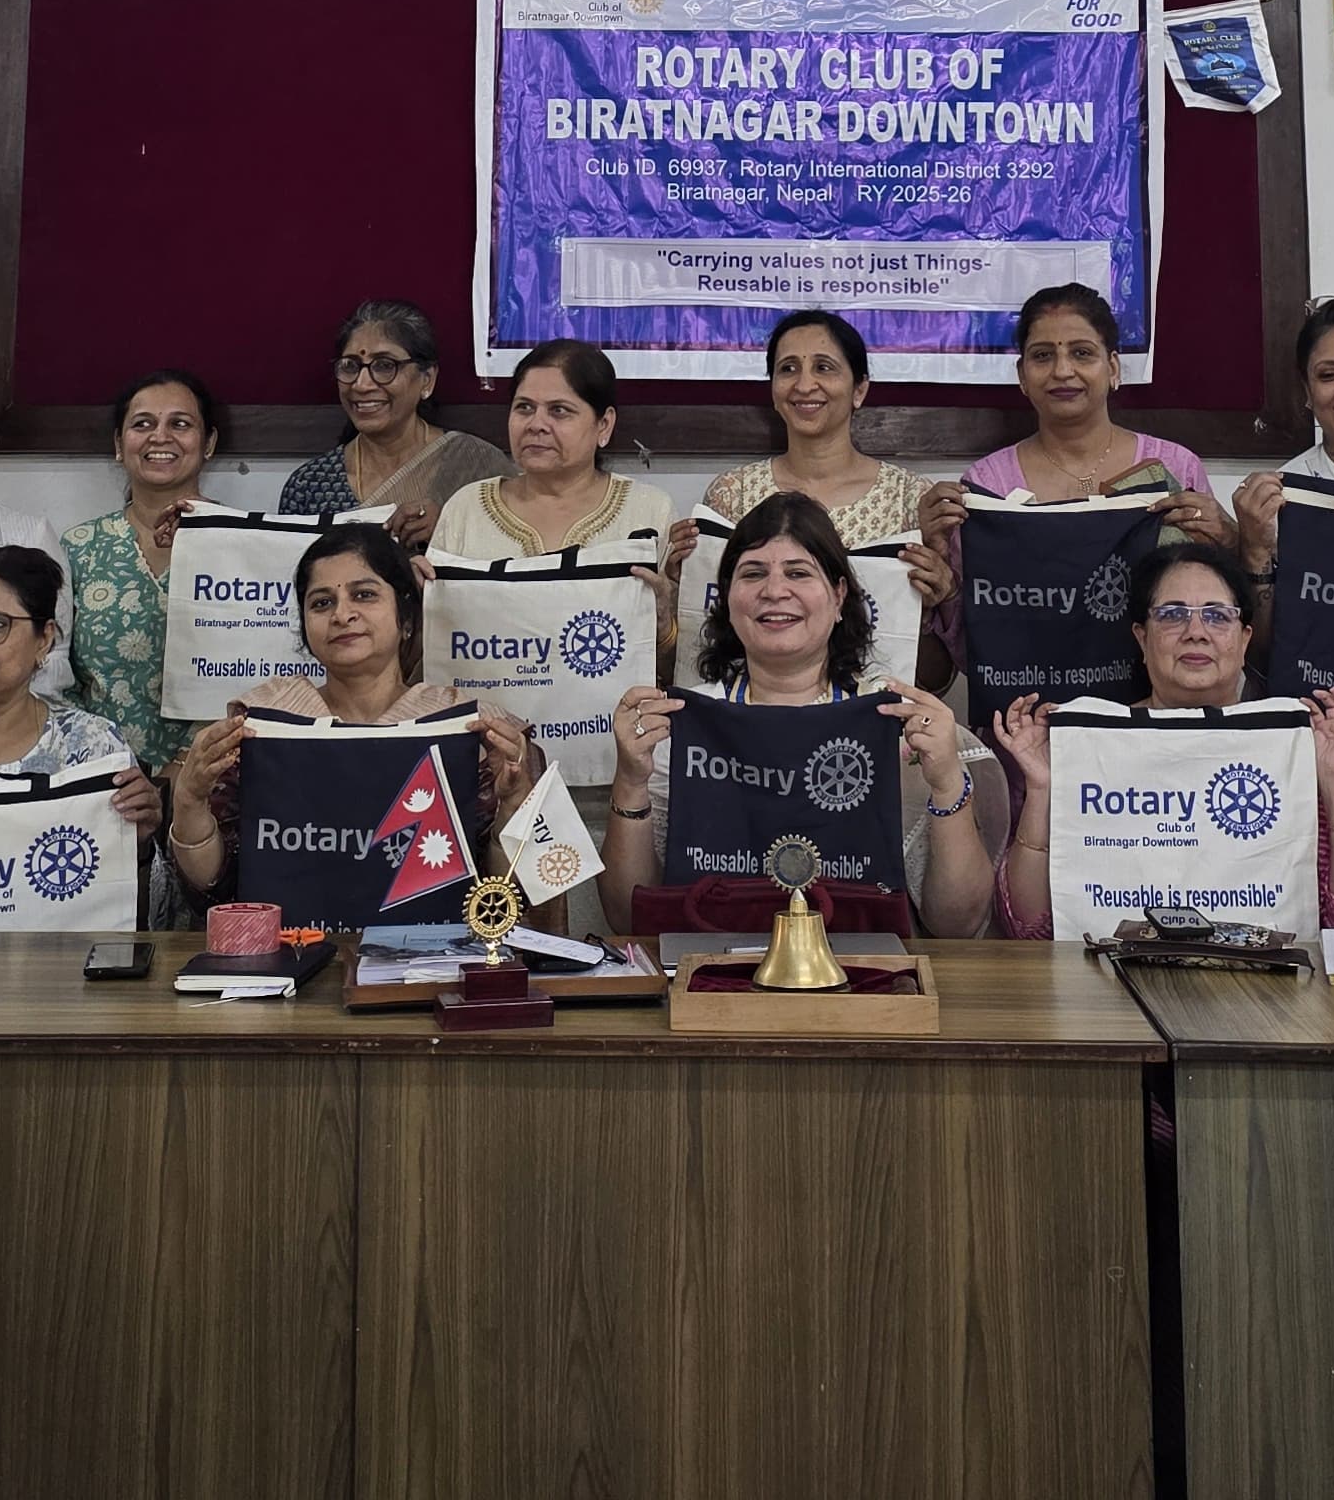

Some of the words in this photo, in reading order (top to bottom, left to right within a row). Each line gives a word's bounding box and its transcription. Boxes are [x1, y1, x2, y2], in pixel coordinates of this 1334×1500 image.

[518, 11, 569, 23] Biratnagar
[573, 12, 623, 22] Downtown
[588, 3, 609, 11] Club
[612, 3, 621, 11] of
[1072, 13, 1122, 27] GOOD
[636, 46, 806, 89] ROTARY
[819, 48, 934, 90] CLUB
[948, 48, 1005, 91] OF
[546, 98, 824, 142] BIRATNAGAR
[838, 101, 1095, 144] DOWNTOWN
[586, 159, 629, 176] Club
[634, 159, 662, 177] ID.
[668, 160, 733, 181] 69937,
[740, 160, 802, 181] Rotary
[809, 160, 928, 179] International
[933, 160, 1001, 180] District
[1006, 162, 1055, 180] 3292
[667, 183, 770, 204] Biratnagar,
[776, 184, 833, 205] Nepal
[858, 185, 887, 203] RY
[893, 185, 971, 203] 2025-26
[658, 249, 753, 272] "Carrying
[760, 252, 826, 270] values
[831, 254, 865, 270] not
[868, 253, 908, 274] just
[914, 253, 991, 274] Things-
[697, 274, 790, 293] Reusable
[797, 275, 814, 293] is
[821, 275, 949, 298] responsible"
[194, 574, 291, 607] Rotary
[973, 578, 1076, 614] Rotary
[256, 607, 276, 616] Club
[279, 608, 288, 616] of
[195, 619, 241, 629] Biratnagar
[244, 619, 289, 627] Downtown
[451, 631, 551, 663] Rotary
[192, 658, 256, 677] "Reusable
[260, 659, 270, 676] is
[516, 665, 538, 674] Club
[541, 665, 550, 673] of
[978, 665, 1046, 686] "Reusable
[1050, 666, 1061, 684] is
[454, 678, 501, 689] Biratnagar
[504, 678, 553, 687] Downtown
[686, 746, 795, 796] Rotary
[1226, 772, 1256, 781] ROTARY
[1081, 783, 1195, 821] Rotary
[1157, 823, 1182, 833] Club
[1185, 823, 1195, 832] of
[1218, 811, 1268, 832] INTERNATIONAL
[47, 833, 79, 843] ROTARY
[257, 818, 373, 860] Rotary
[1084, 837, 1139, 849] Biratnagar
[1142, 837, 1198, 847] Downtown
[687, 847, 758, 873] "Reusable
[3, 889, 13, 899] of
[1085, 884, 1163, 908] "Reusable
[1168, 885, 1181, 908] is
[1186, 884, 1282, 911] responsible"
